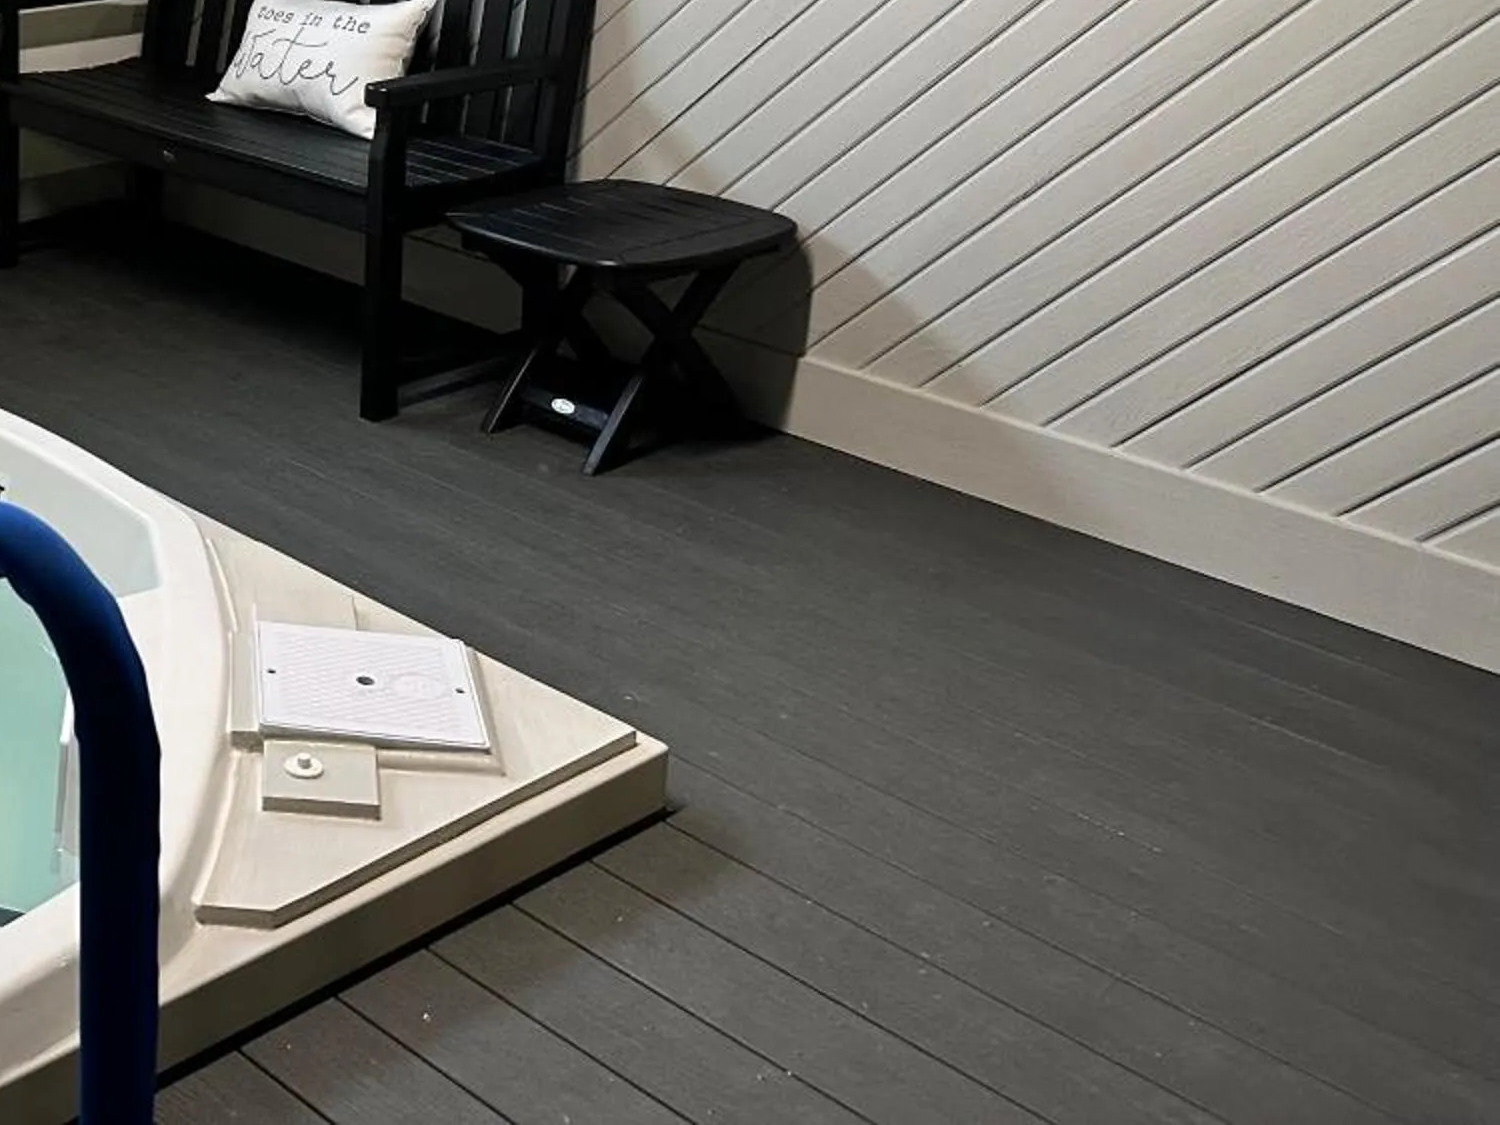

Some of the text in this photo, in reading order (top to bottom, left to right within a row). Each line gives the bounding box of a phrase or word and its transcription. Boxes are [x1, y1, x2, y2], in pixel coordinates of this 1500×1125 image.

[257, 5, 371, 34] toes in the
